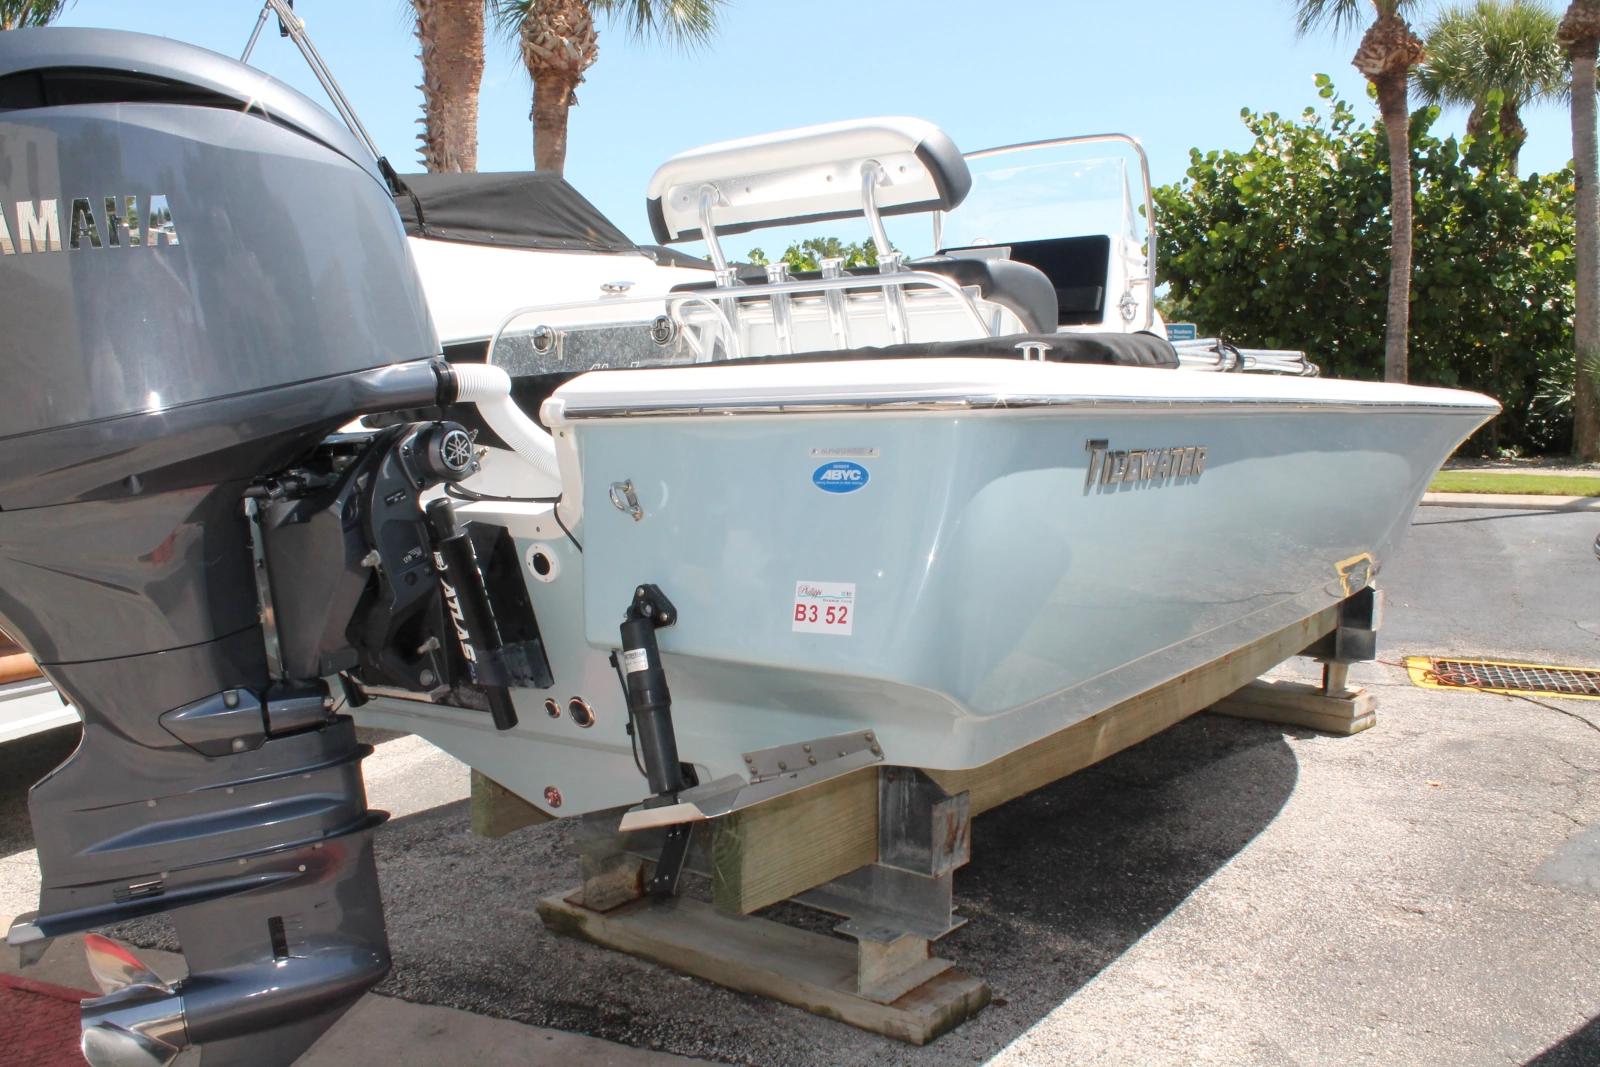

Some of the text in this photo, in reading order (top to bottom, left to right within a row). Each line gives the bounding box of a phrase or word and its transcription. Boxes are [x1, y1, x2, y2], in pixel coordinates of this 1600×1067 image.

[820, 469, 861, 480] ABYC
[1085, 439, 1208, 486] TIDEWATER
[440, 577, 478, 664] ATLAS
[795, 604, 848, 624] B3 52
